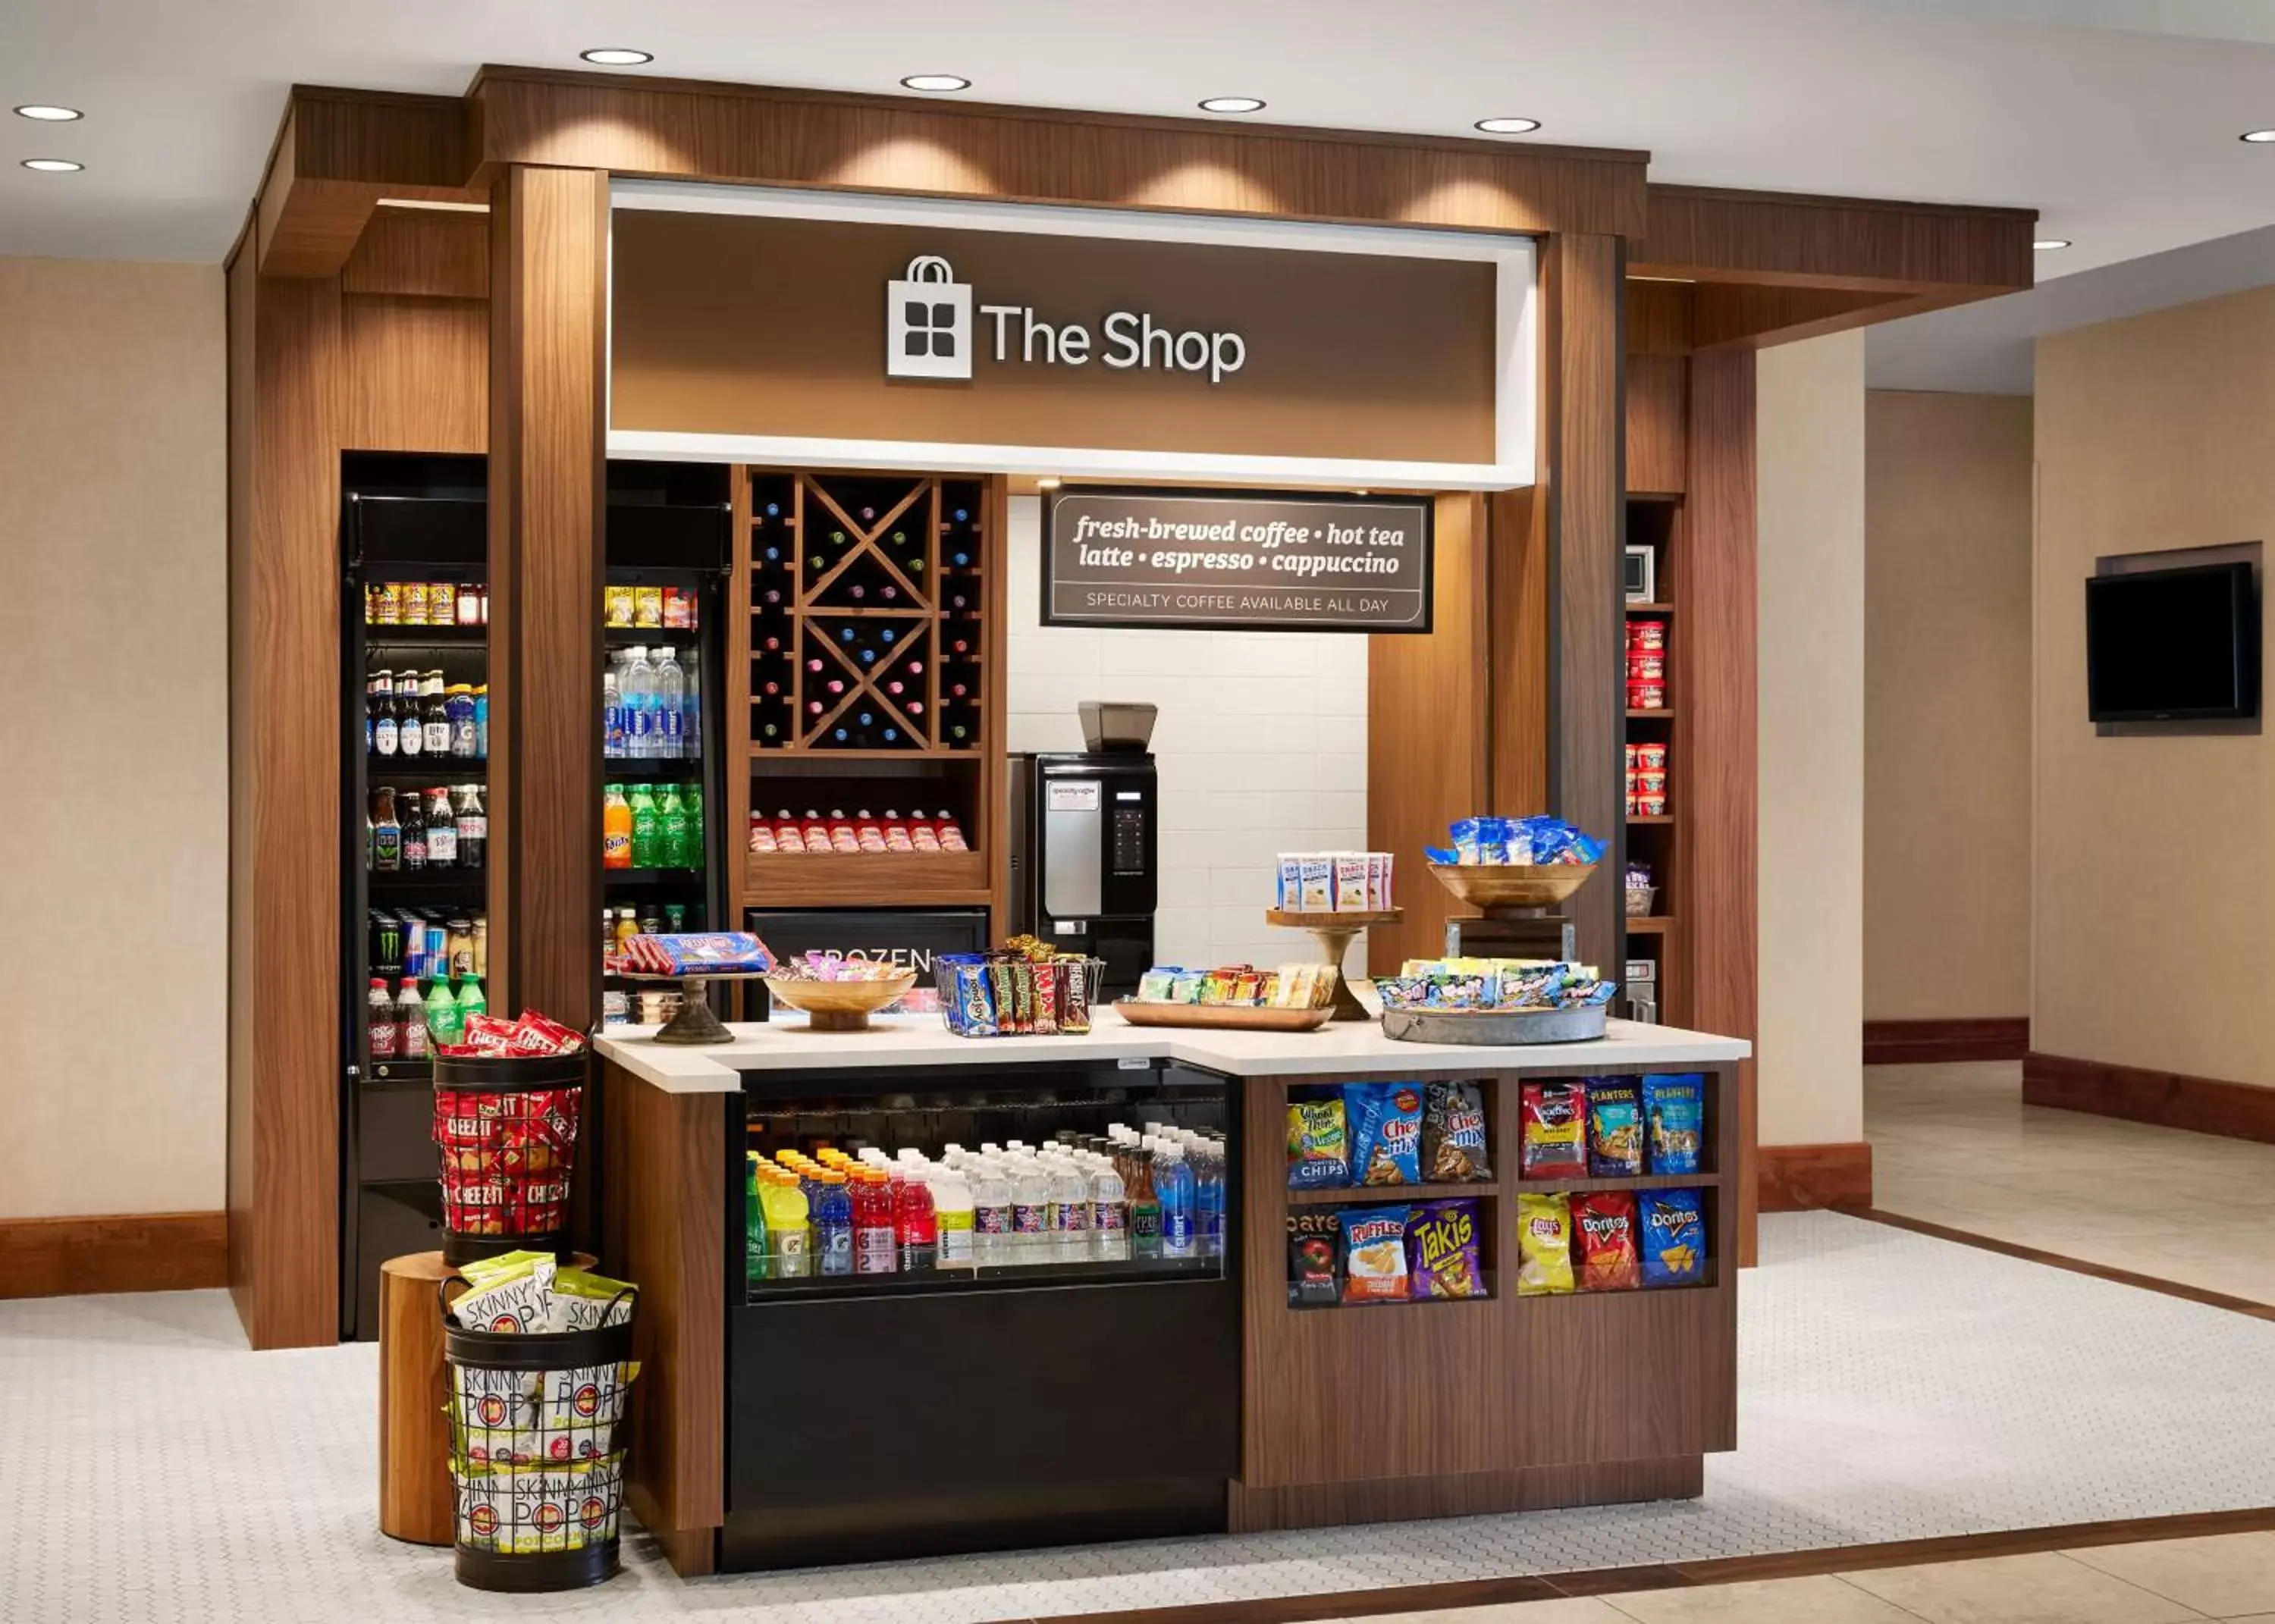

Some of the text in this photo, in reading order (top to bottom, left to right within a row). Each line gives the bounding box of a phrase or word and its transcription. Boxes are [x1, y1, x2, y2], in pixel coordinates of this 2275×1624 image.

[981, 305, 1246, 383] The Shop
[1074, 515, 1404, 547] fresh-brewed coffee hot tea
[1079, 544, 1399, 577] latte espresso cappuccino
[1087, 592, 1389, 613] SPECIALTY COFFEE AVAILABLE ALL DAY
[1590, 1089, 1634, 1101] PLANTERS
[1301, 1165, 1344, 1177] CHIPS
[1583, 1215, 1629, 1233] Doritos
[1652, 1210, 1699, 1228] Doritos
[466, 1282, 529, 1325] SKINNY
